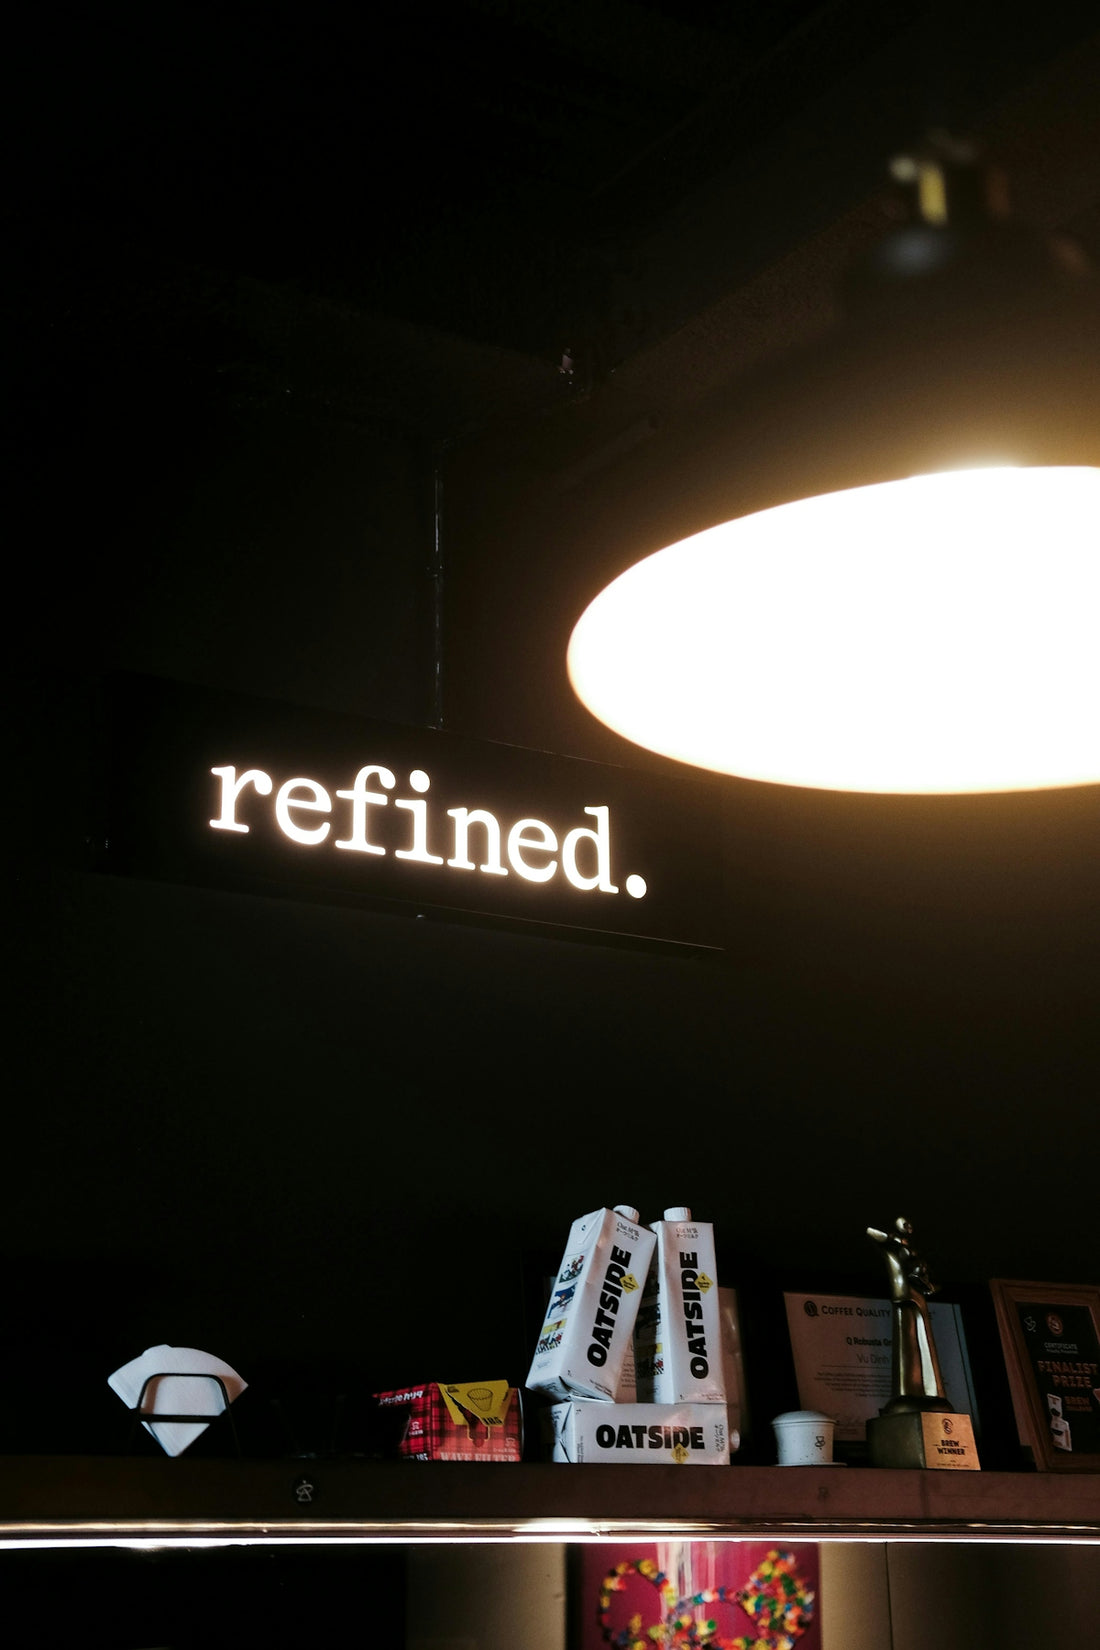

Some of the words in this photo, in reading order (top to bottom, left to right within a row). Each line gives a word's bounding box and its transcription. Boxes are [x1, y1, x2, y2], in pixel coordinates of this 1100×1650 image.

[209, 765, 647, 898] refined.
[587, 1245, 632, 1367] OATSIDE
[821, 1304, 854, 1316] COFFEE
[856, 1307, 892, 1318] QUALITY
[679, 1251, 709, 1379] OATSIDE
[1036, 1360, 1097, 1375] FINALIST
[1051, 1374, 1092, 1388] PRIZE
[596, 1424, 705, 1450] OATSIDE
[941, 1439, 960, 1447] BREW
[936, 1447, 965, 1456] WINNER
